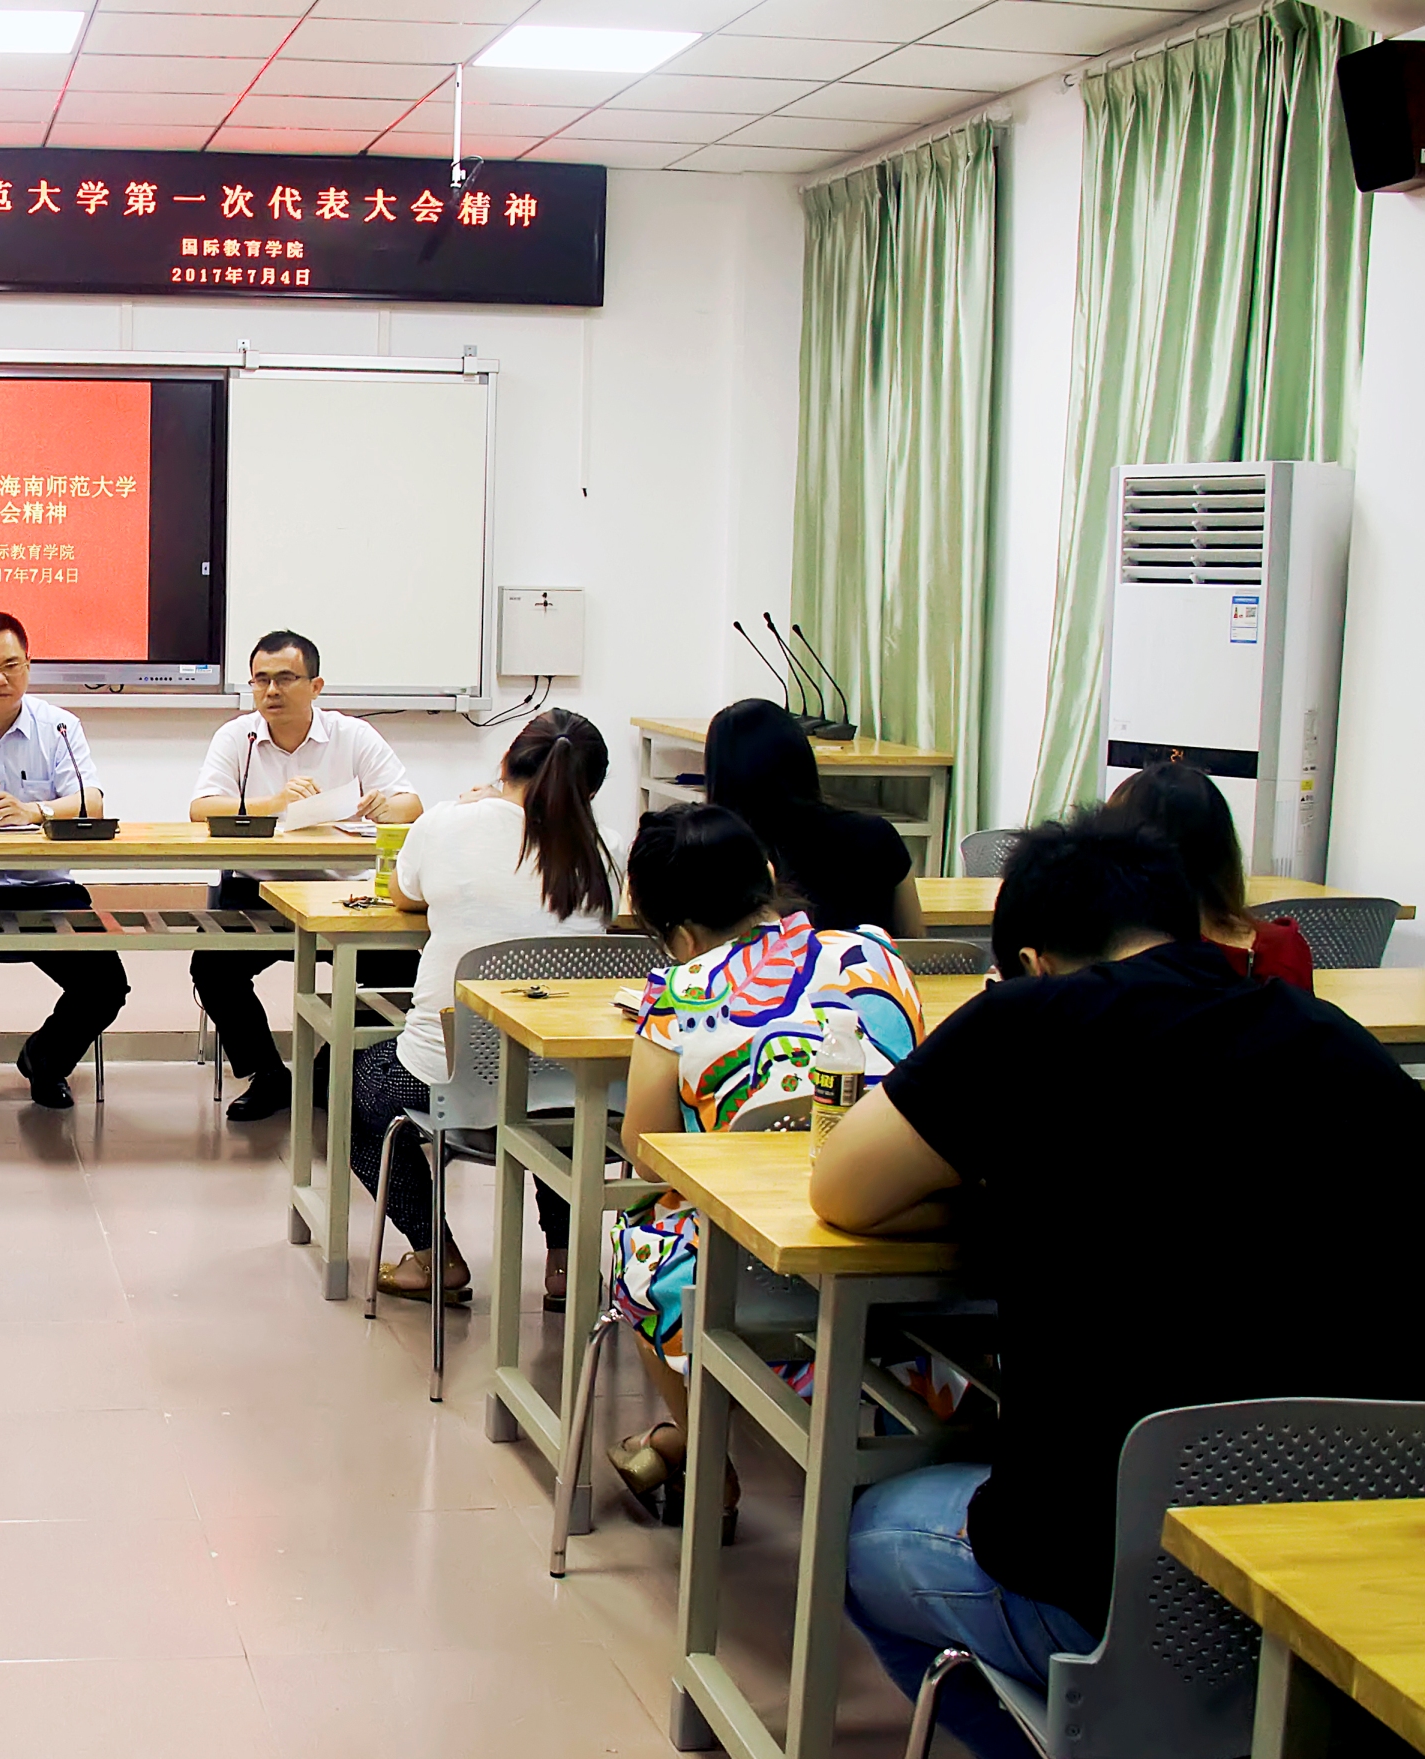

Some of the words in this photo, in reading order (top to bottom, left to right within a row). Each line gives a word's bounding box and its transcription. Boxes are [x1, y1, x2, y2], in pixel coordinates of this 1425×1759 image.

[181, 237, 304, 259] 国际教育学院
[171, 266, 311, 286] 2017年7月4日
